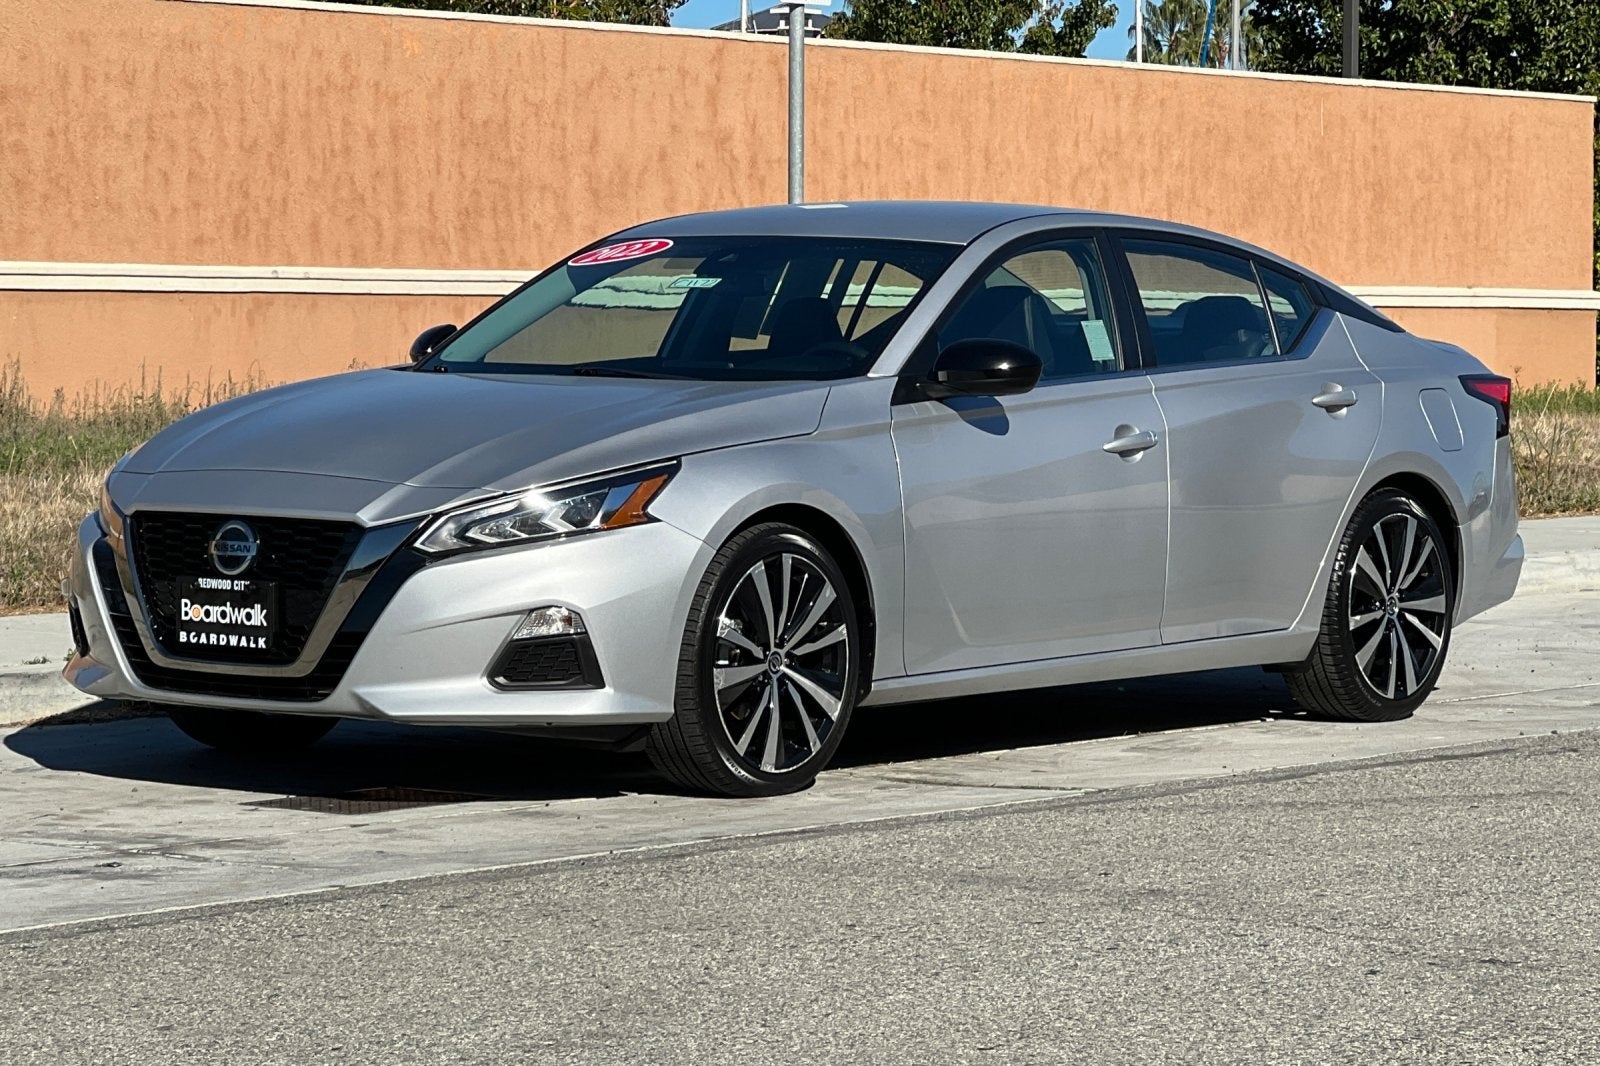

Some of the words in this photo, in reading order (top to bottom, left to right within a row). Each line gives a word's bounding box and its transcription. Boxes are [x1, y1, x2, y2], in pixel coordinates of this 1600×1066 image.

[579, 241, 659, 263] 2022
[214, 542, 251, 553] NISSAN
[198, 577, 232, 590] REDWOOD
[181, 599, 267, 627] Boardwalk
[179, 631, 266, 649] BOARDWALK
